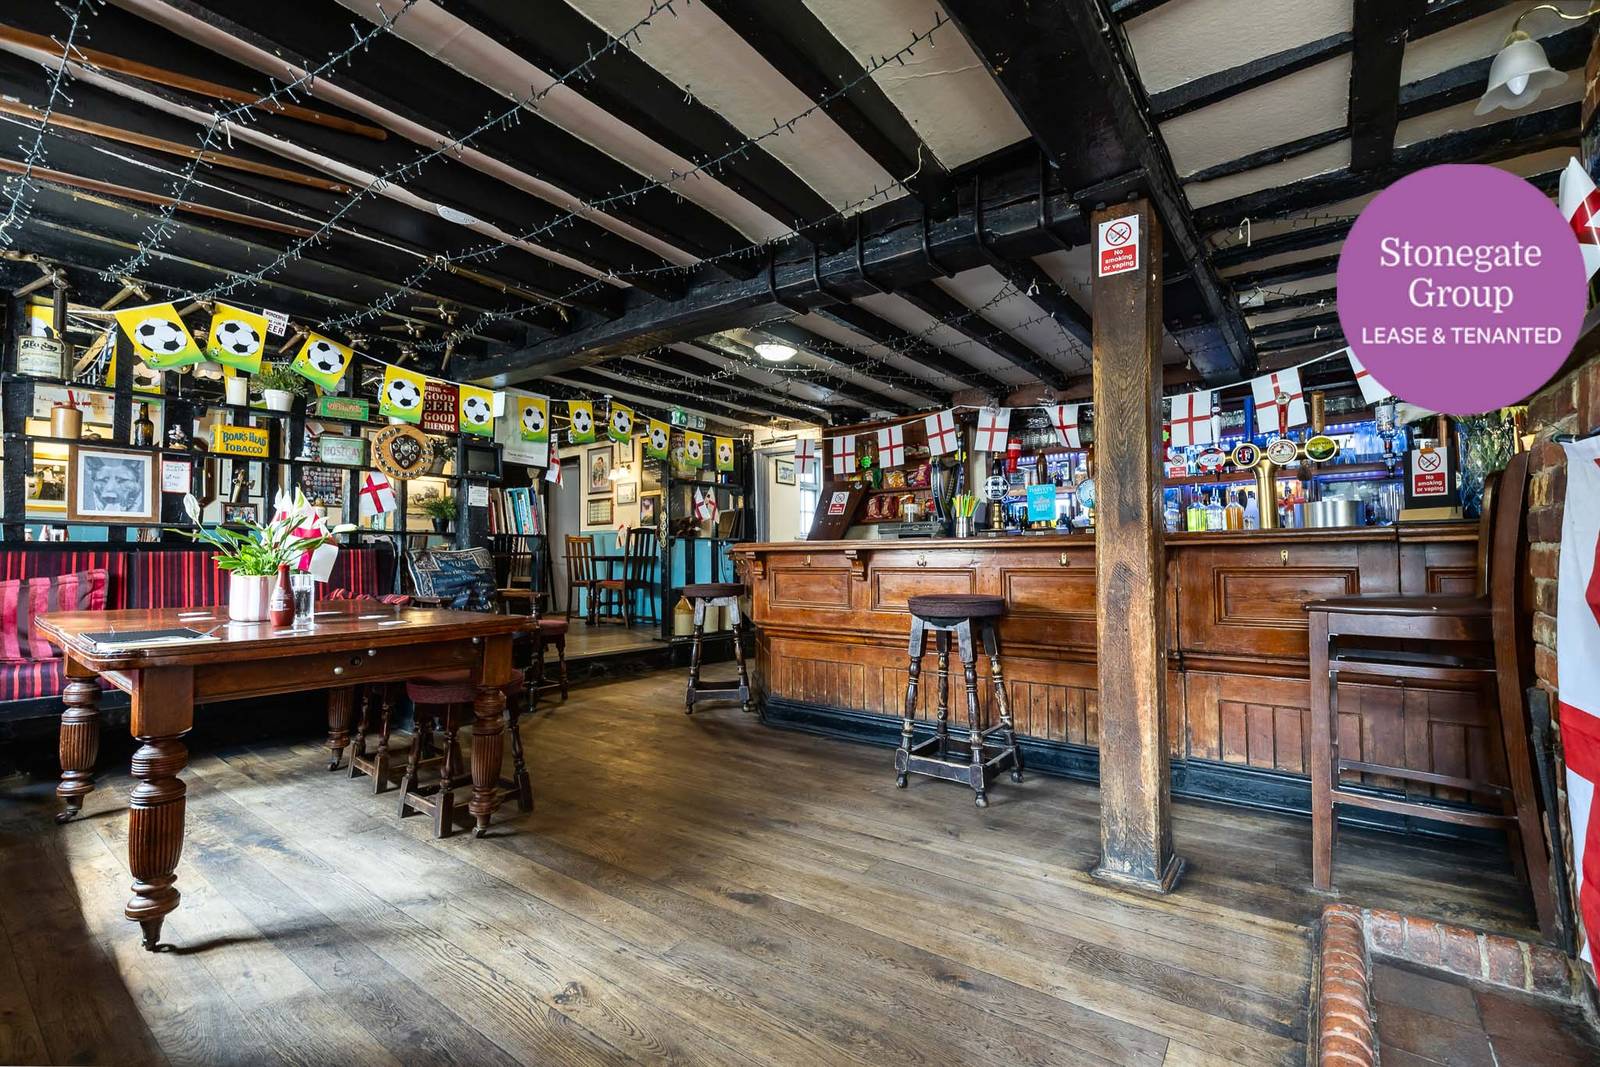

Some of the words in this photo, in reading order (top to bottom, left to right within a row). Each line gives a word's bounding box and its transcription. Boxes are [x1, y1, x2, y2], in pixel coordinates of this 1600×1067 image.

[1105, 254, 1133, 264] smoking
[1112, 260, 1134, 269] vaping
[424, 391, 455, 402] GOOD
[423, 412, 456, 423] GOOD
[225, 443, 263, 454] TOBACCO
